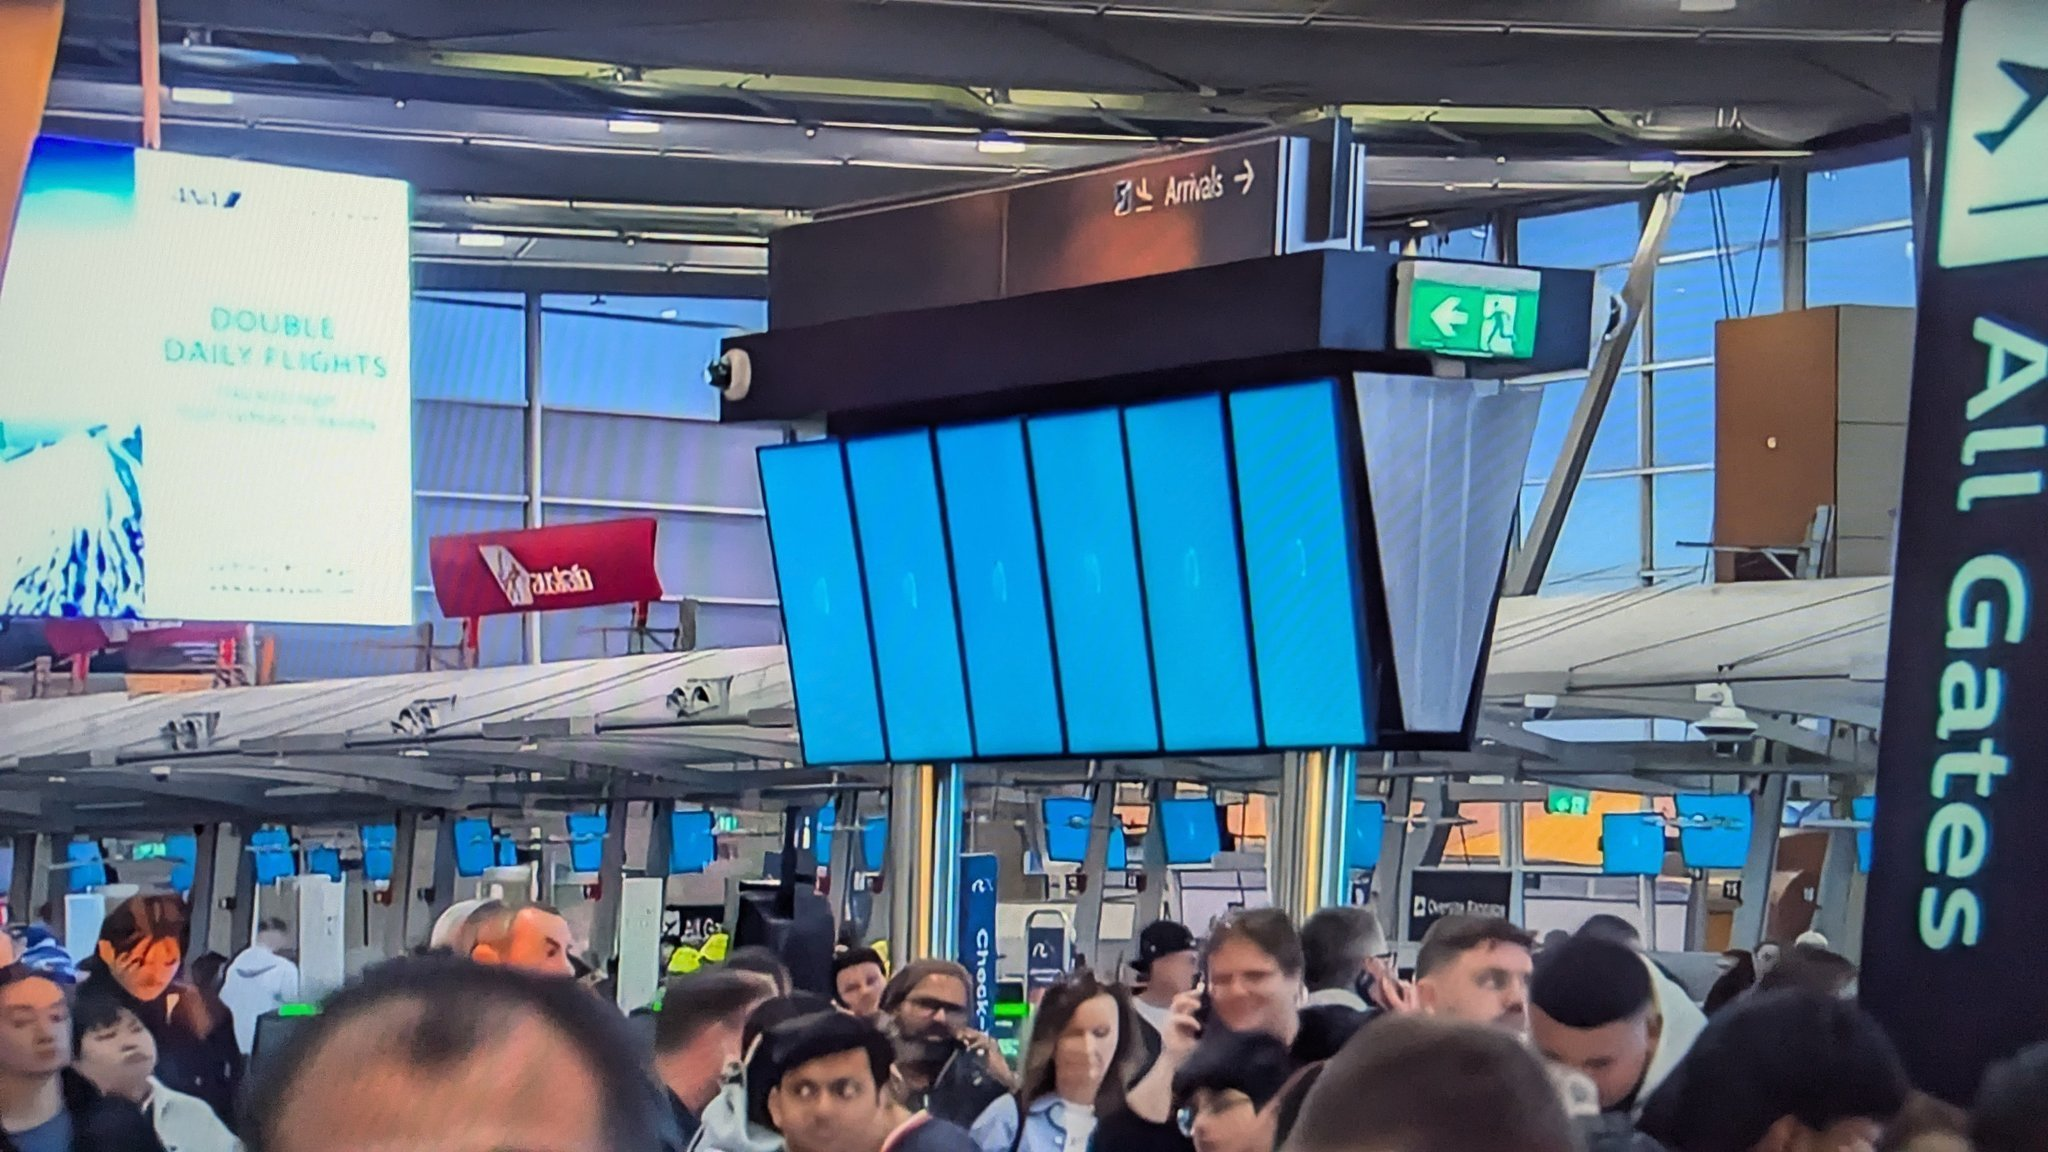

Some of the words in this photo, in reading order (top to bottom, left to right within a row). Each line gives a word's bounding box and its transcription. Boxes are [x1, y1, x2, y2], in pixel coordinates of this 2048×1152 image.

[1164, 164, 1224, 206] Arrivals
[210, 306, 335, 340] DOUBLE
[163, 337, 253, 367] DAILY
[264, 346, 387, 379] FLIGHTS
[1957, 315, 2048, 512] All
[1919, 554, 2029, 950] Gates
